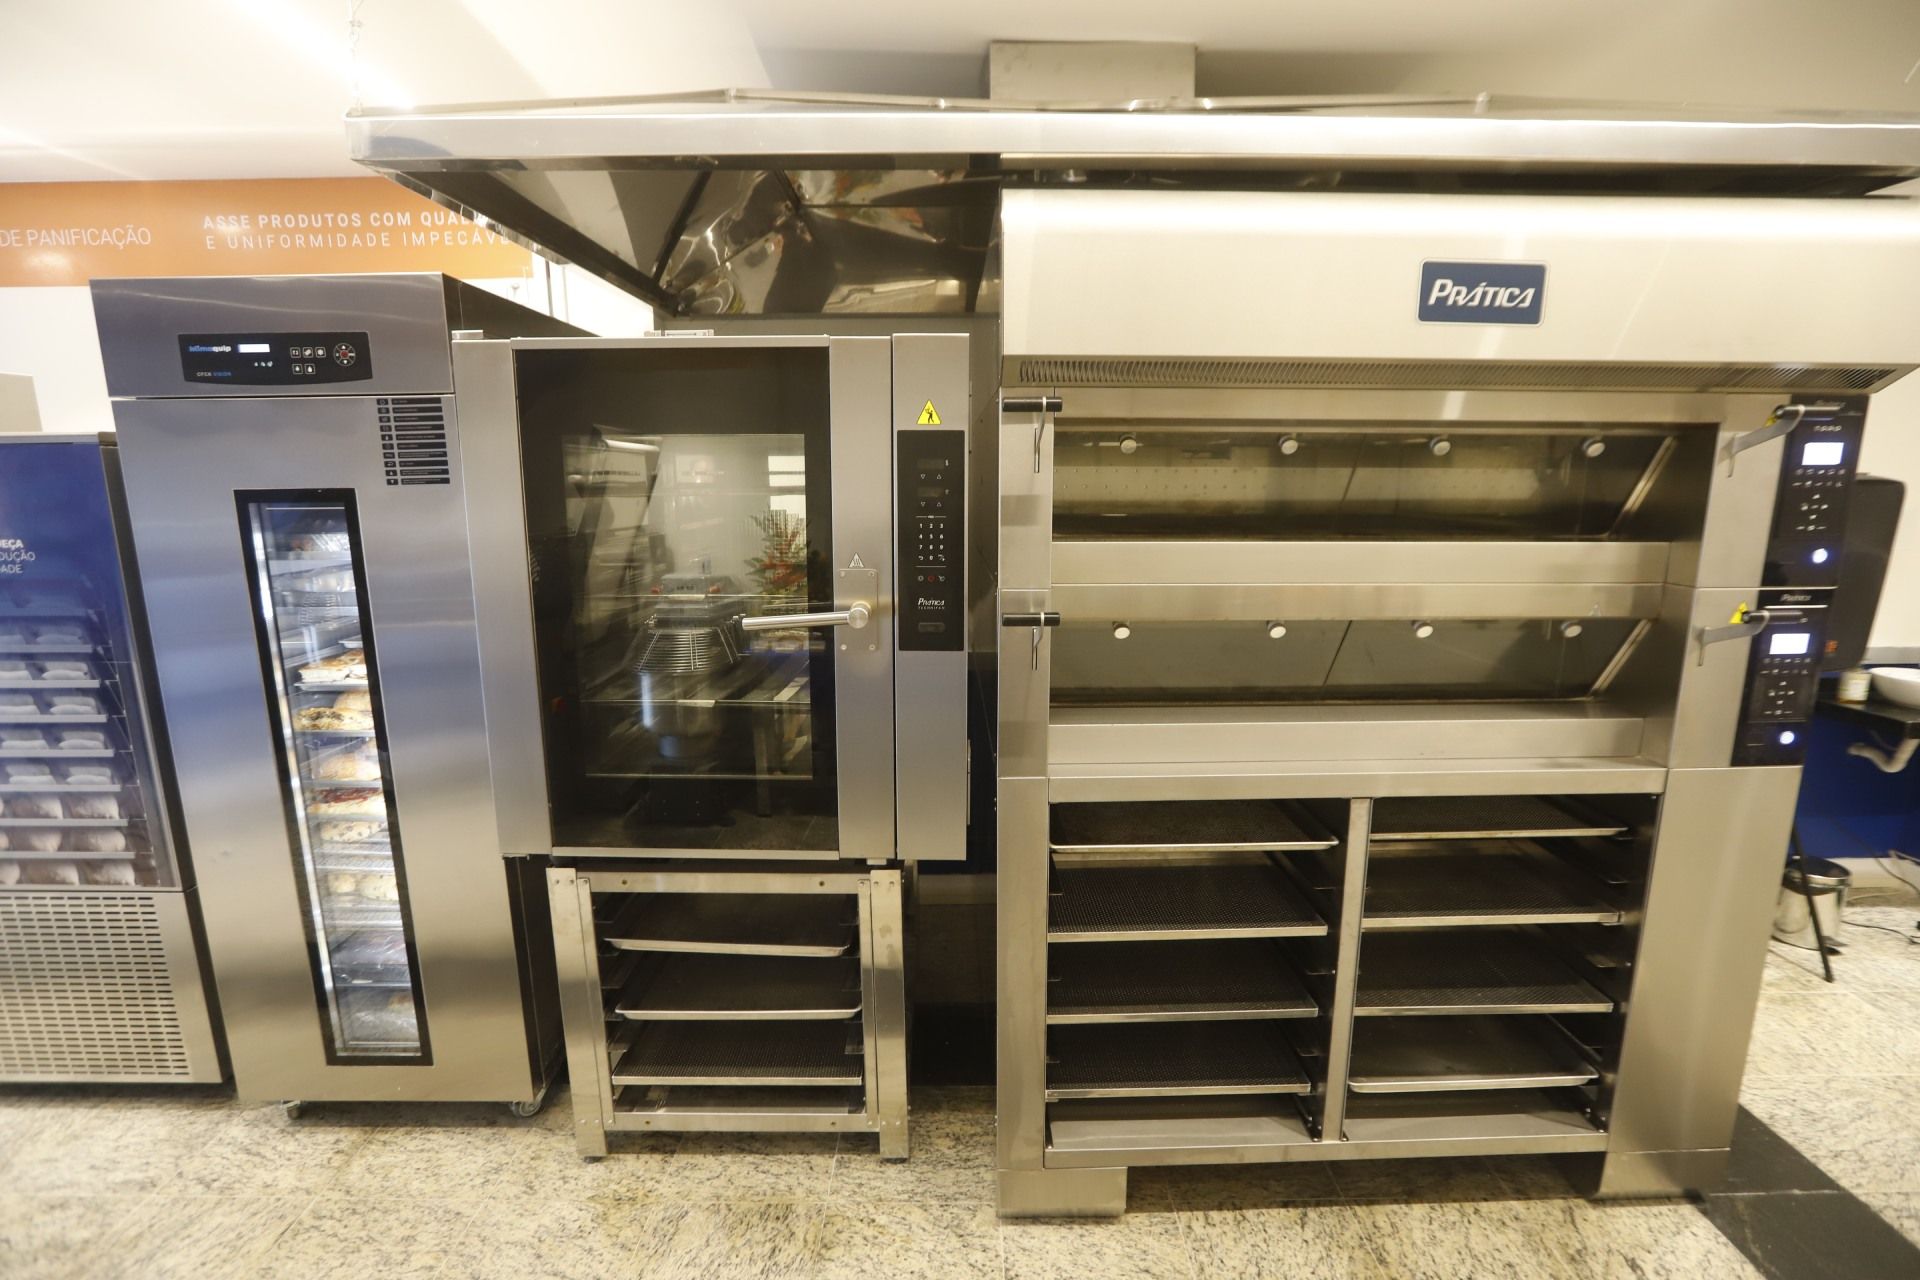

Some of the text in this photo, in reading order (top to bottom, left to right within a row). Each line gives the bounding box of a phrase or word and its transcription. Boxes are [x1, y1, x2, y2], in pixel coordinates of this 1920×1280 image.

[203, 211, 474, 230] ASSE PRODUTOS COM QUAL
[0, 224, 152, 249] DE PANIFICAÇÃO
[206, 235, 216, 249] E
[227, 231, 392, 249] UNIFORMIDADE
